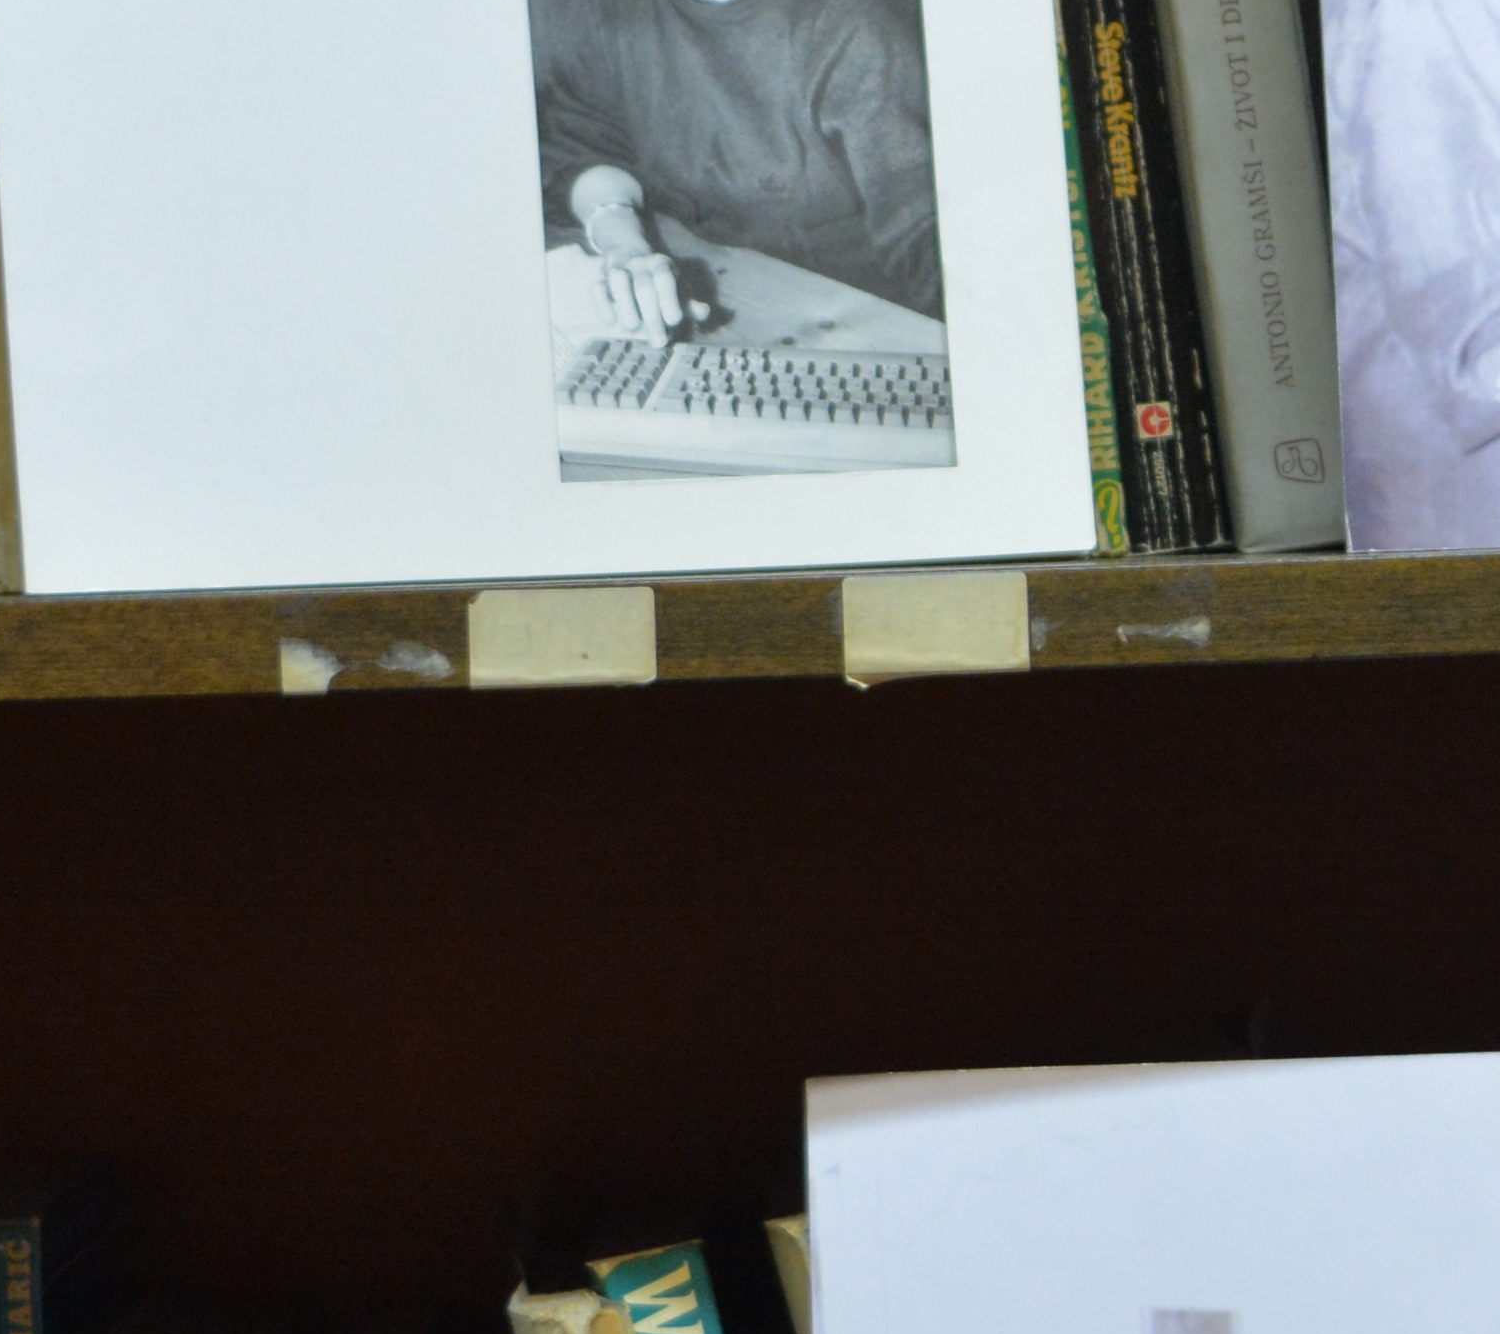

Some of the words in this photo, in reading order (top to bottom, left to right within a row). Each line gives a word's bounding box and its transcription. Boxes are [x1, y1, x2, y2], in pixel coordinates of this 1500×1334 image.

[1093, 21, 1125, 101] Steve
[1228, 52, 1262, 133] ŽIVOT
[1104, 102, 1139, 200] Krantz
[1242, 158, 1278, 264] GRAMŠI
[1259, 270, 1297, 389] ANTONIO
